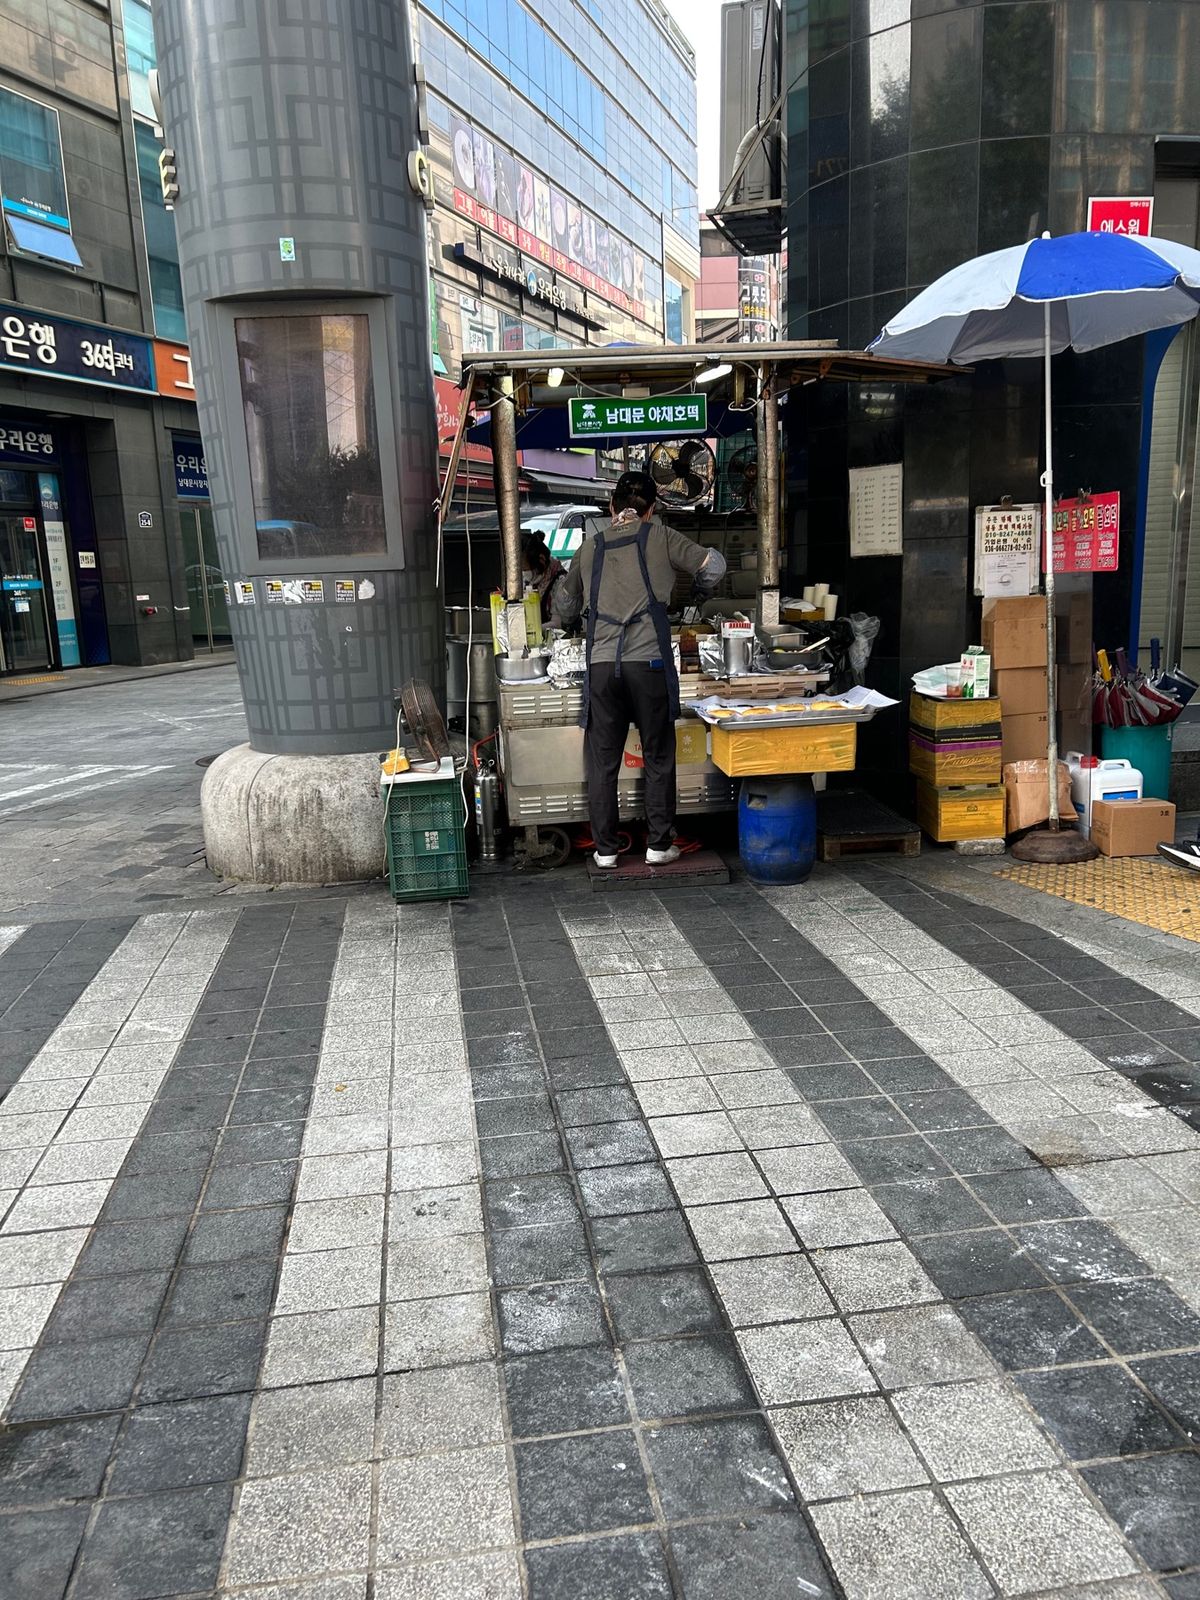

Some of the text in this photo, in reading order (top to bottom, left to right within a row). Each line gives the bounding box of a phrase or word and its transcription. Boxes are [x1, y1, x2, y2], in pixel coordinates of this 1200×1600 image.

[1100, 219, 1140, 235] 에스원
[538, 277, 567, 311] 우리은행
[1, 316, 57, 364] 은행
[606, 404, 699, 424] 남대문 야채호떡
[0, 428, 53, 454] 우리은행
